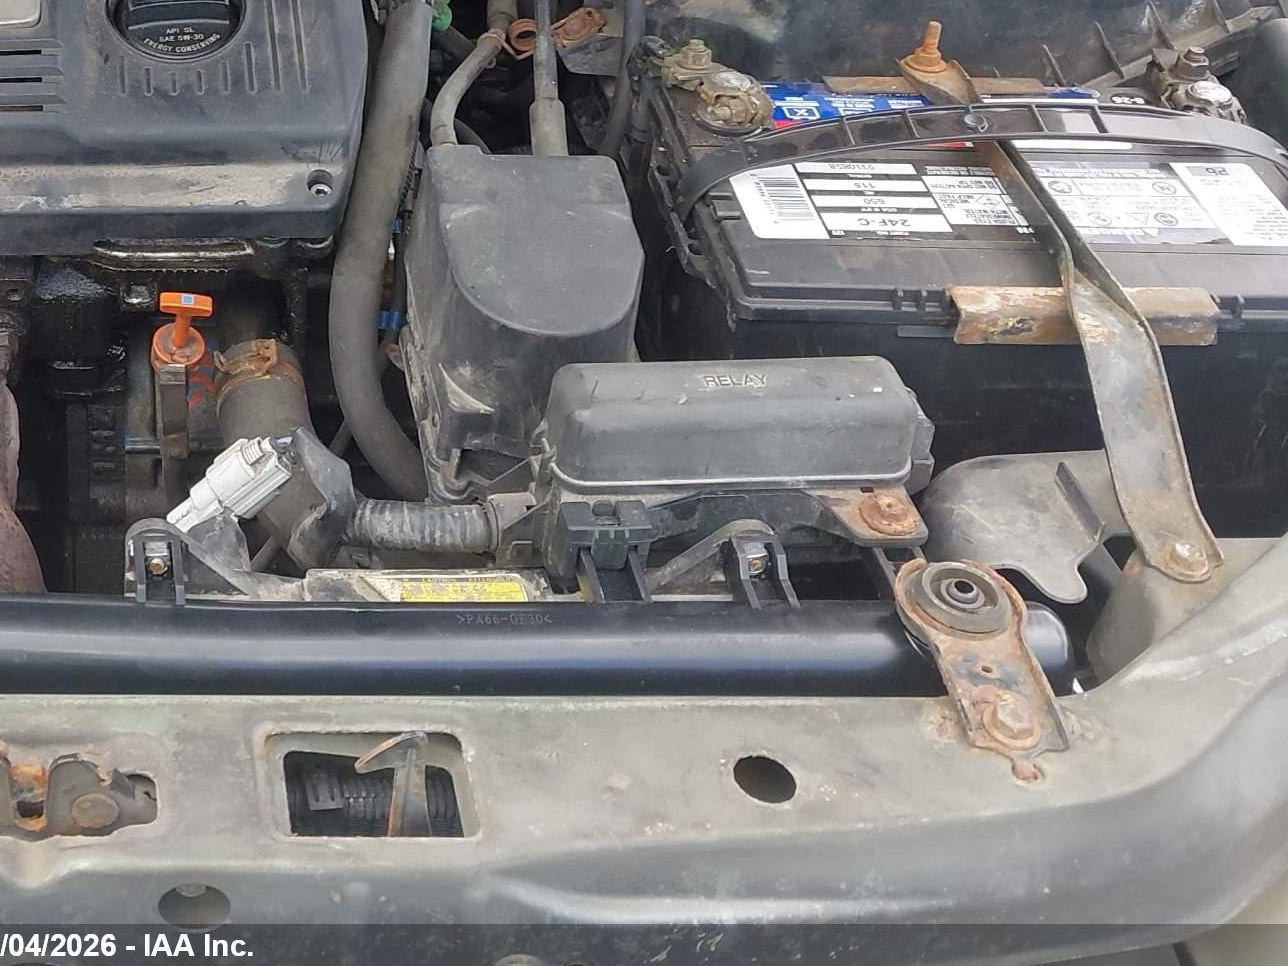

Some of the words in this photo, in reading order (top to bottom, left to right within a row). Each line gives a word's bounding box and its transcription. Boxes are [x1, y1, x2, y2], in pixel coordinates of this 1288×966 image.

[165, 27, 180, 35] API
[143, 37, 174, 53] ENERGY
[175, 33, 222, 53] CONSERVING
[159, 35, 175, 43] SAE
[177, 34, 205, 42] 5W-30
[857, 218, 912, 227] 24F-C
[702, 373, 768, 388] RELAY
